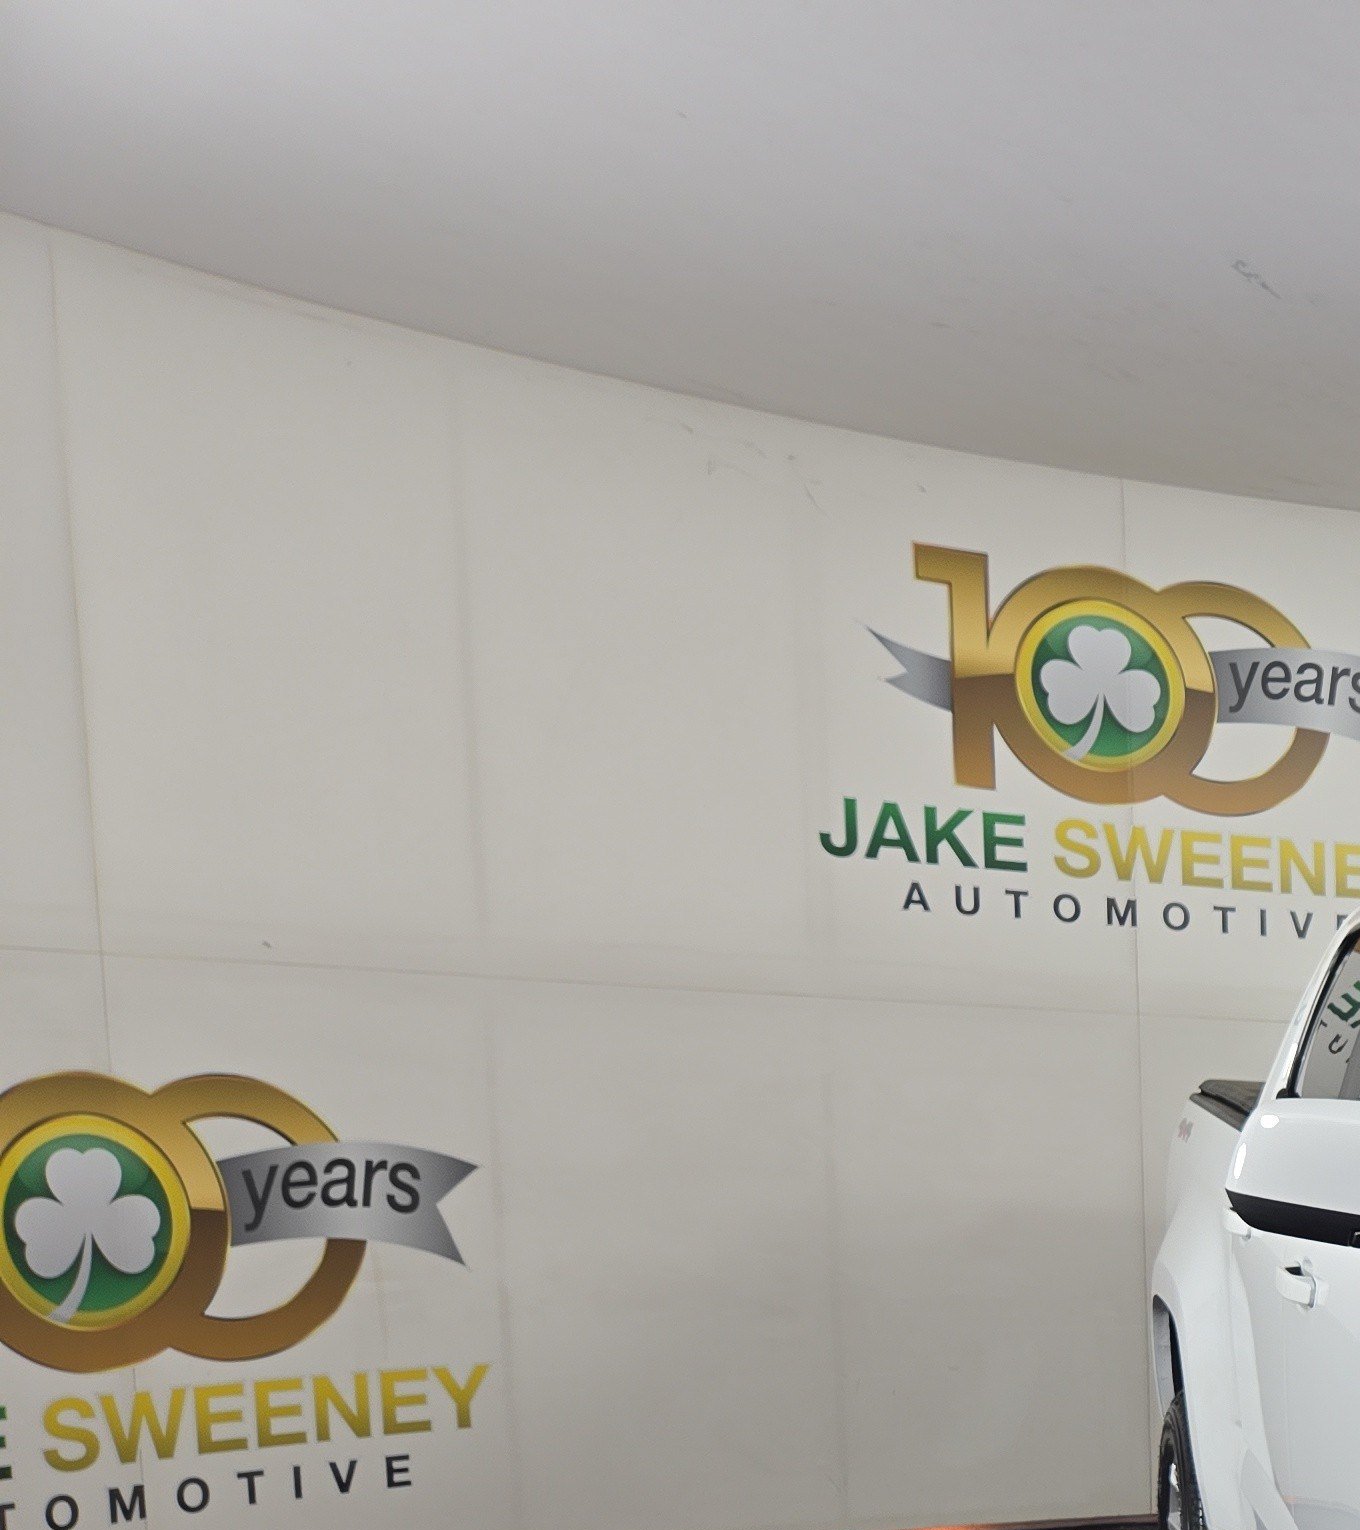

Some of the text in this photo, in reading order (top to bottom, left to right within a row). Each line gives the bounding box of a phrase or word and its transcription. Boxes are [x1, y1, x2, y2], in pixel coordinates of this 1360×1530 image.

[818, 796, 1029, 873] JAKE
[902, 881, 1347, 940] AUTOMOTIV
[241, 1155, 422, 1233] years
[42, 1362, 491, 1473] SWEENEY
